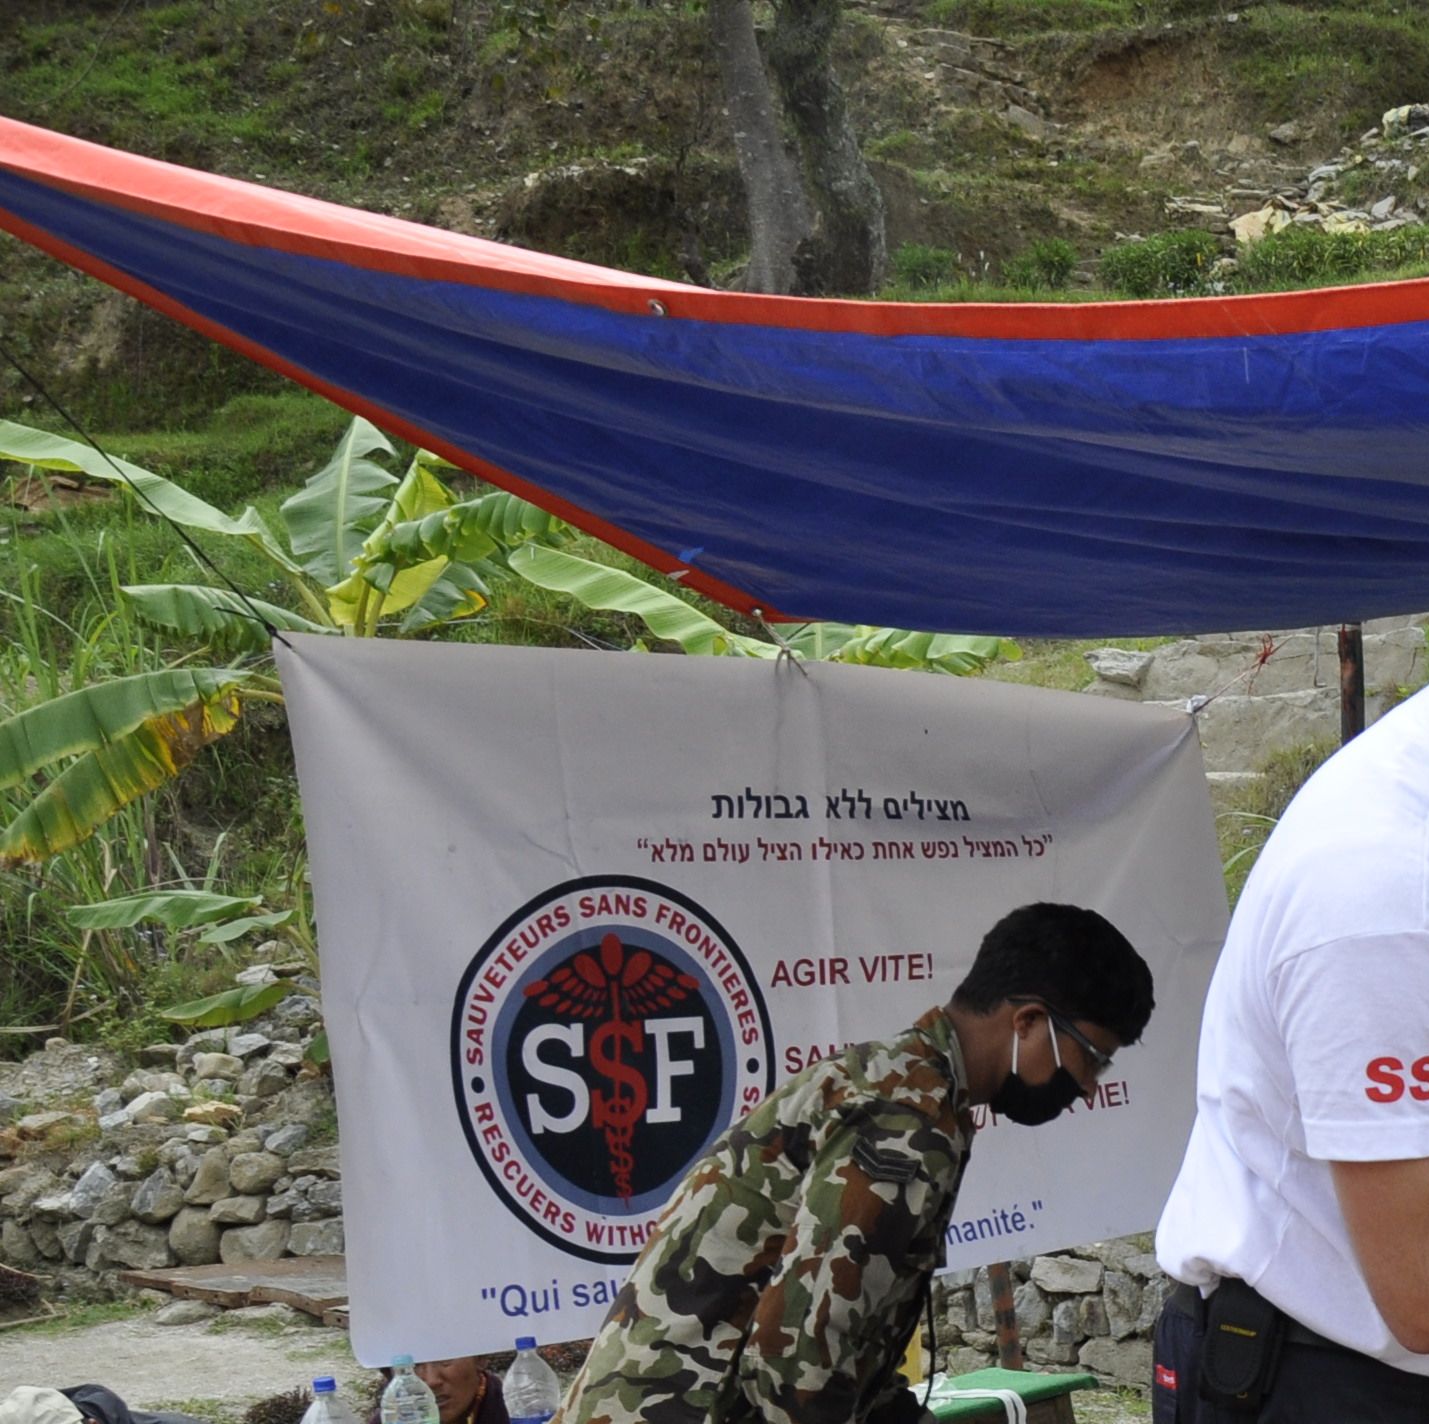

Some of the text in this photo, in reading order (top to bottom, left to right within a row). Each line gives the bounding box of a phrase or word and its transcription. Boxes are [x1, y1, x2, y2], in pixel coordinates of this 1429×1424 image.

[711, 787, 971, 821] מצילים ללא גבולות
[703, 837, 749, 864] עולם
[757, 837, 802, 861] הציל
[812, 837, 865, 861] כאילו
[872, 841, 915, 860] אחת
[921, 840, 959, 859] נפש
[962, 835, 1018, 858] המציל
[466, 893, 759, 1066] SAUVETEURS SANS FRONTIERES
[770, 953, 933, 988] AGIR VITE!
[521, 1016, 706, 1135] SSF
[474, 1101, 578, 1233] RESCUERS
[481, 1279, 560, 1317] "Qui
